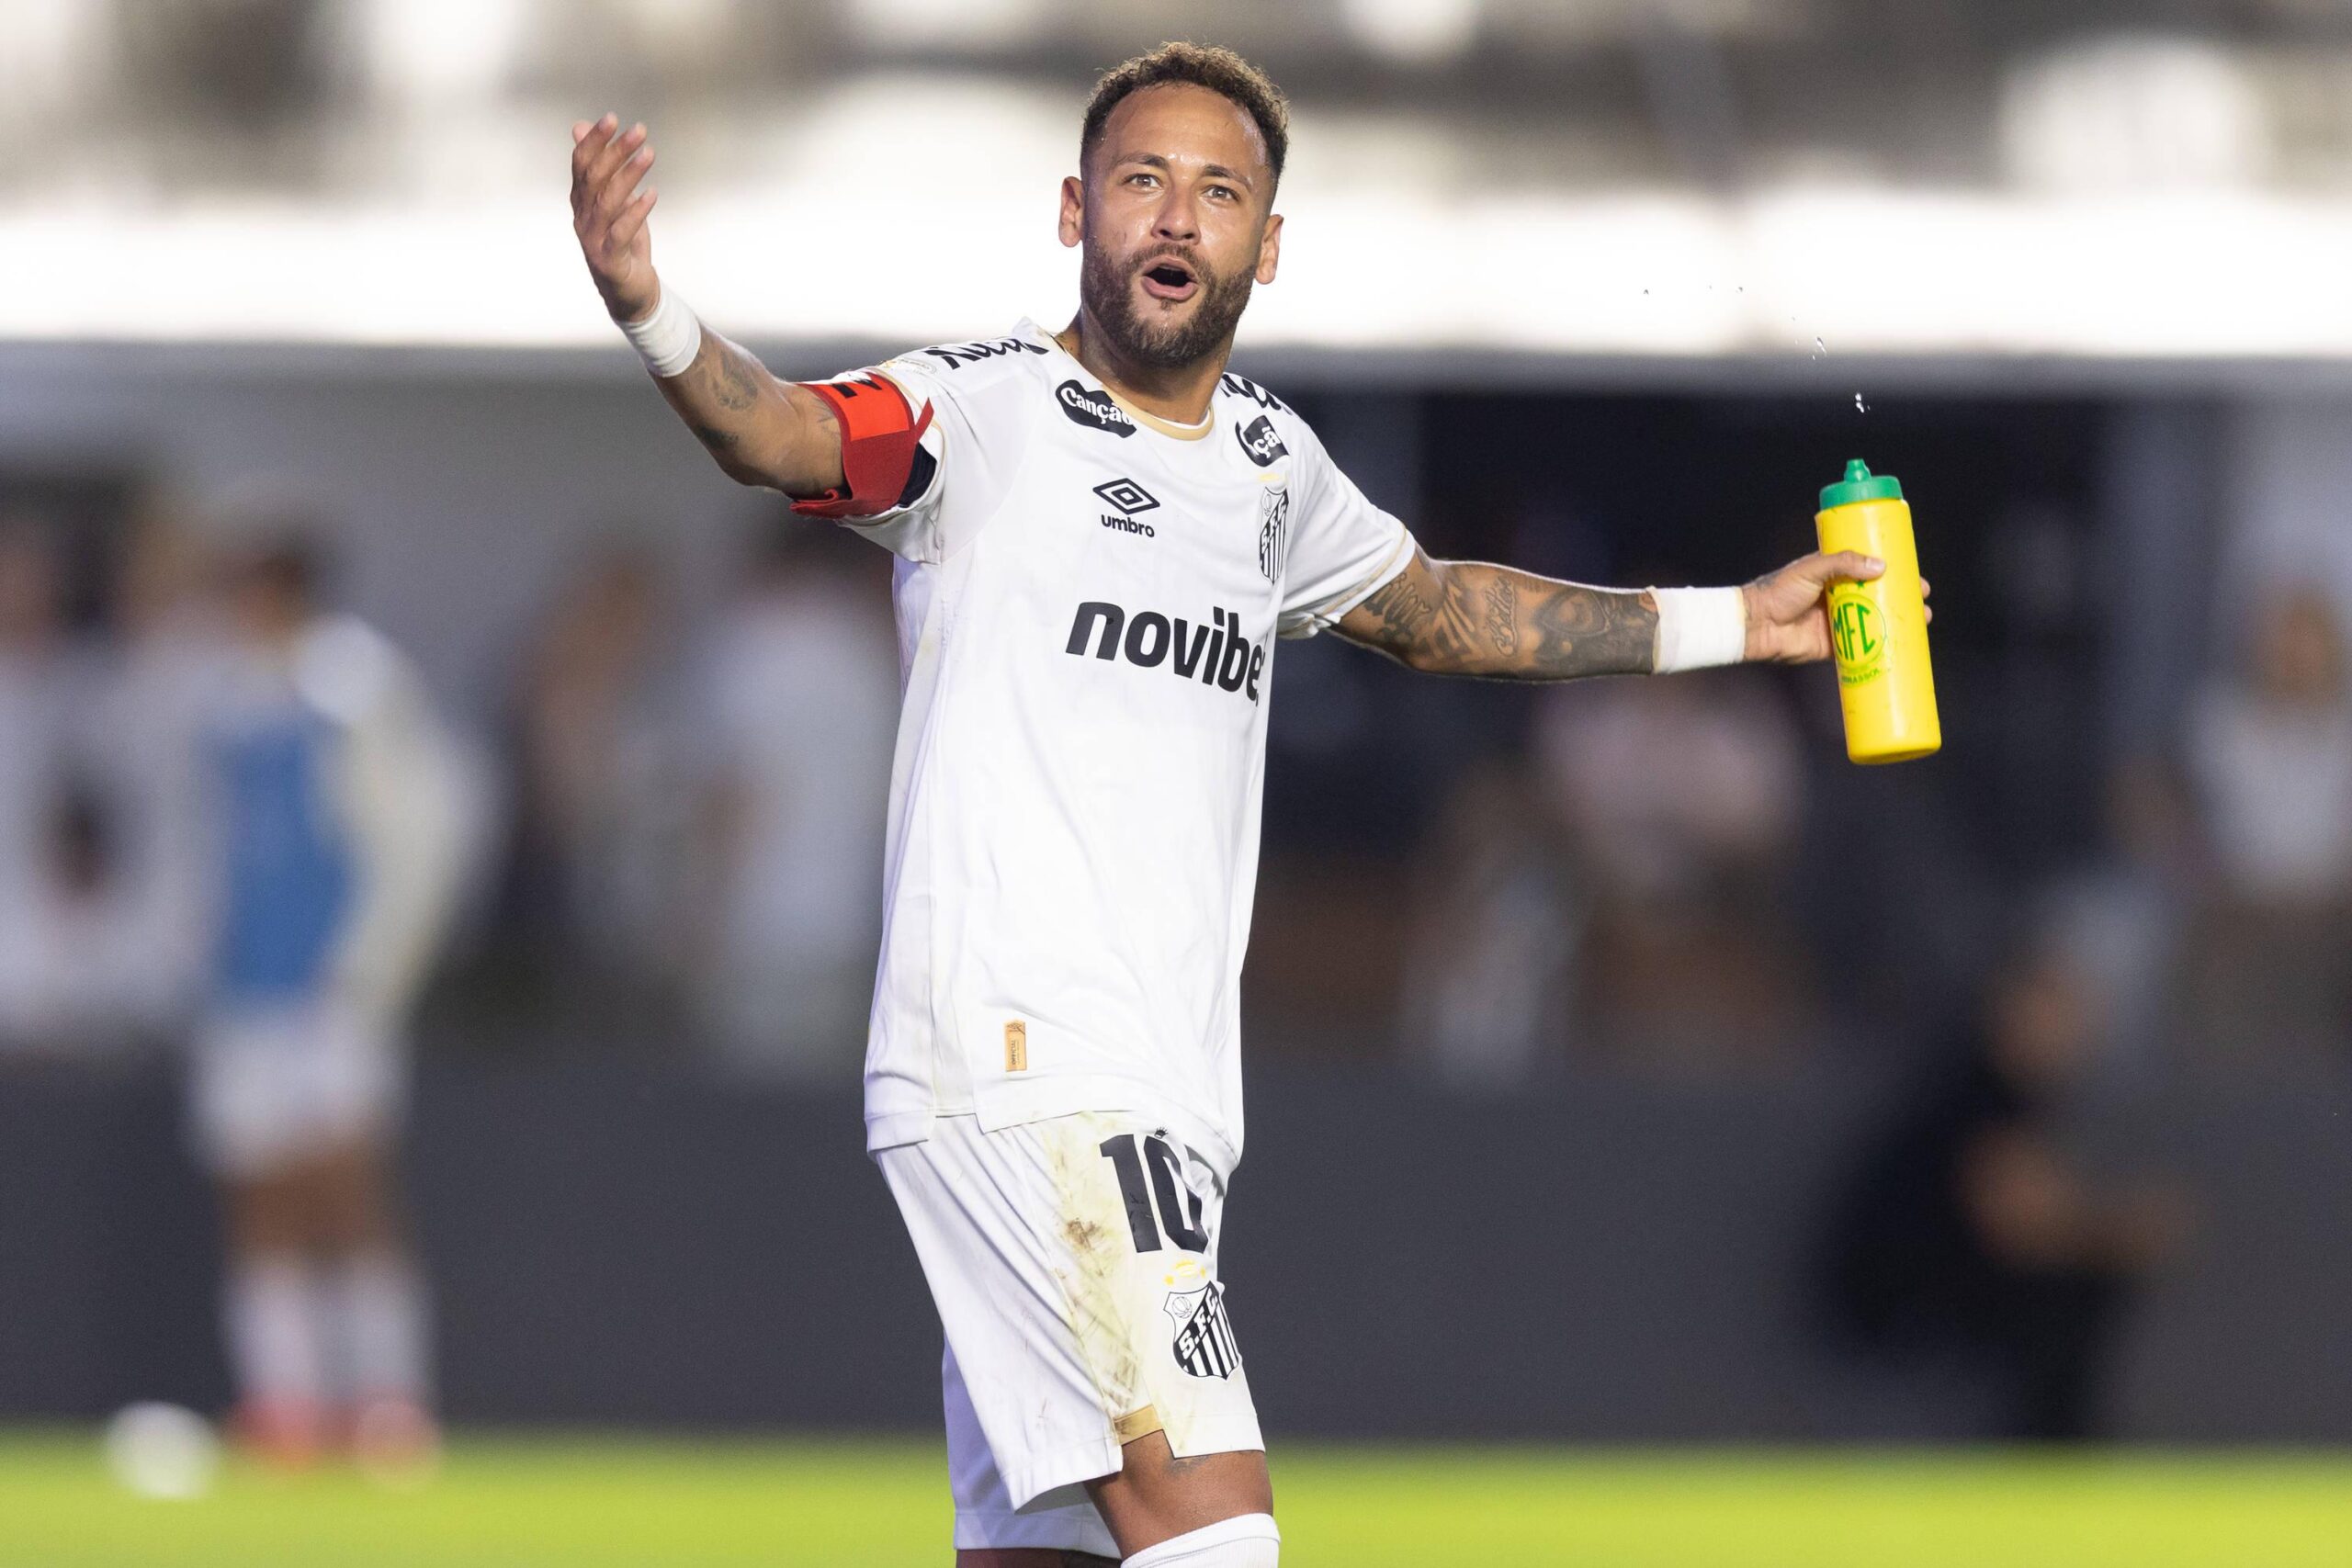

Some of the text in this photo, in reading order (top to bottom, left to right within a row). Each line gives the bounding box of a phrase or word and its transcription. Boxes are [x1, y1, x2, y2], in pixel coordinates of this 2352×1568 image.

[1101, 513, 1155, 538] umbro
[1066, 602, 1267, 706] novibe
[1833, 603, 1876, 660] MFC
[1100, 1134, 1209, 1255] 10
